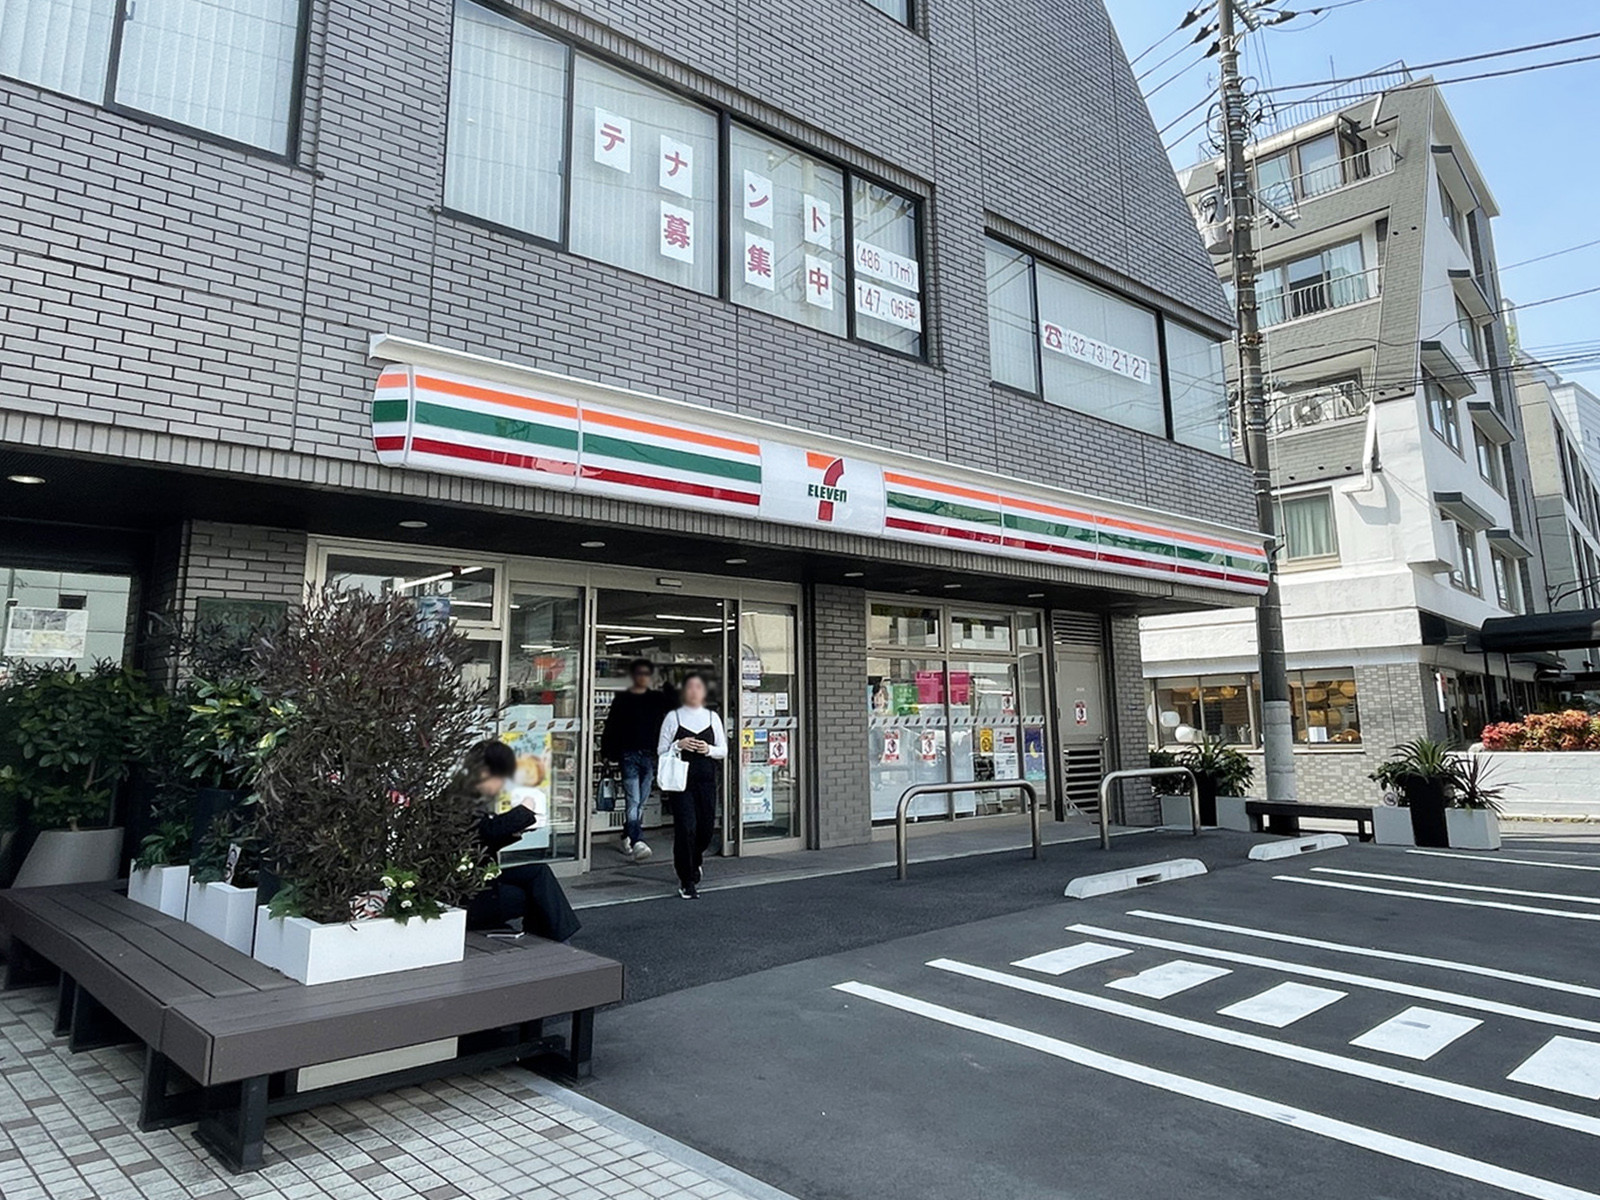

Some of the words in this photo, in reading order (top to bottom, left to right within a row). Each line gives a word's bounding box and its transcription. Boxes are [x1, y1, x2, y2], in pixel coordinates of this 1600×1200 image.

[600, 122, 826, 233] テナント
[663, 213, 830, 296] 募集中
